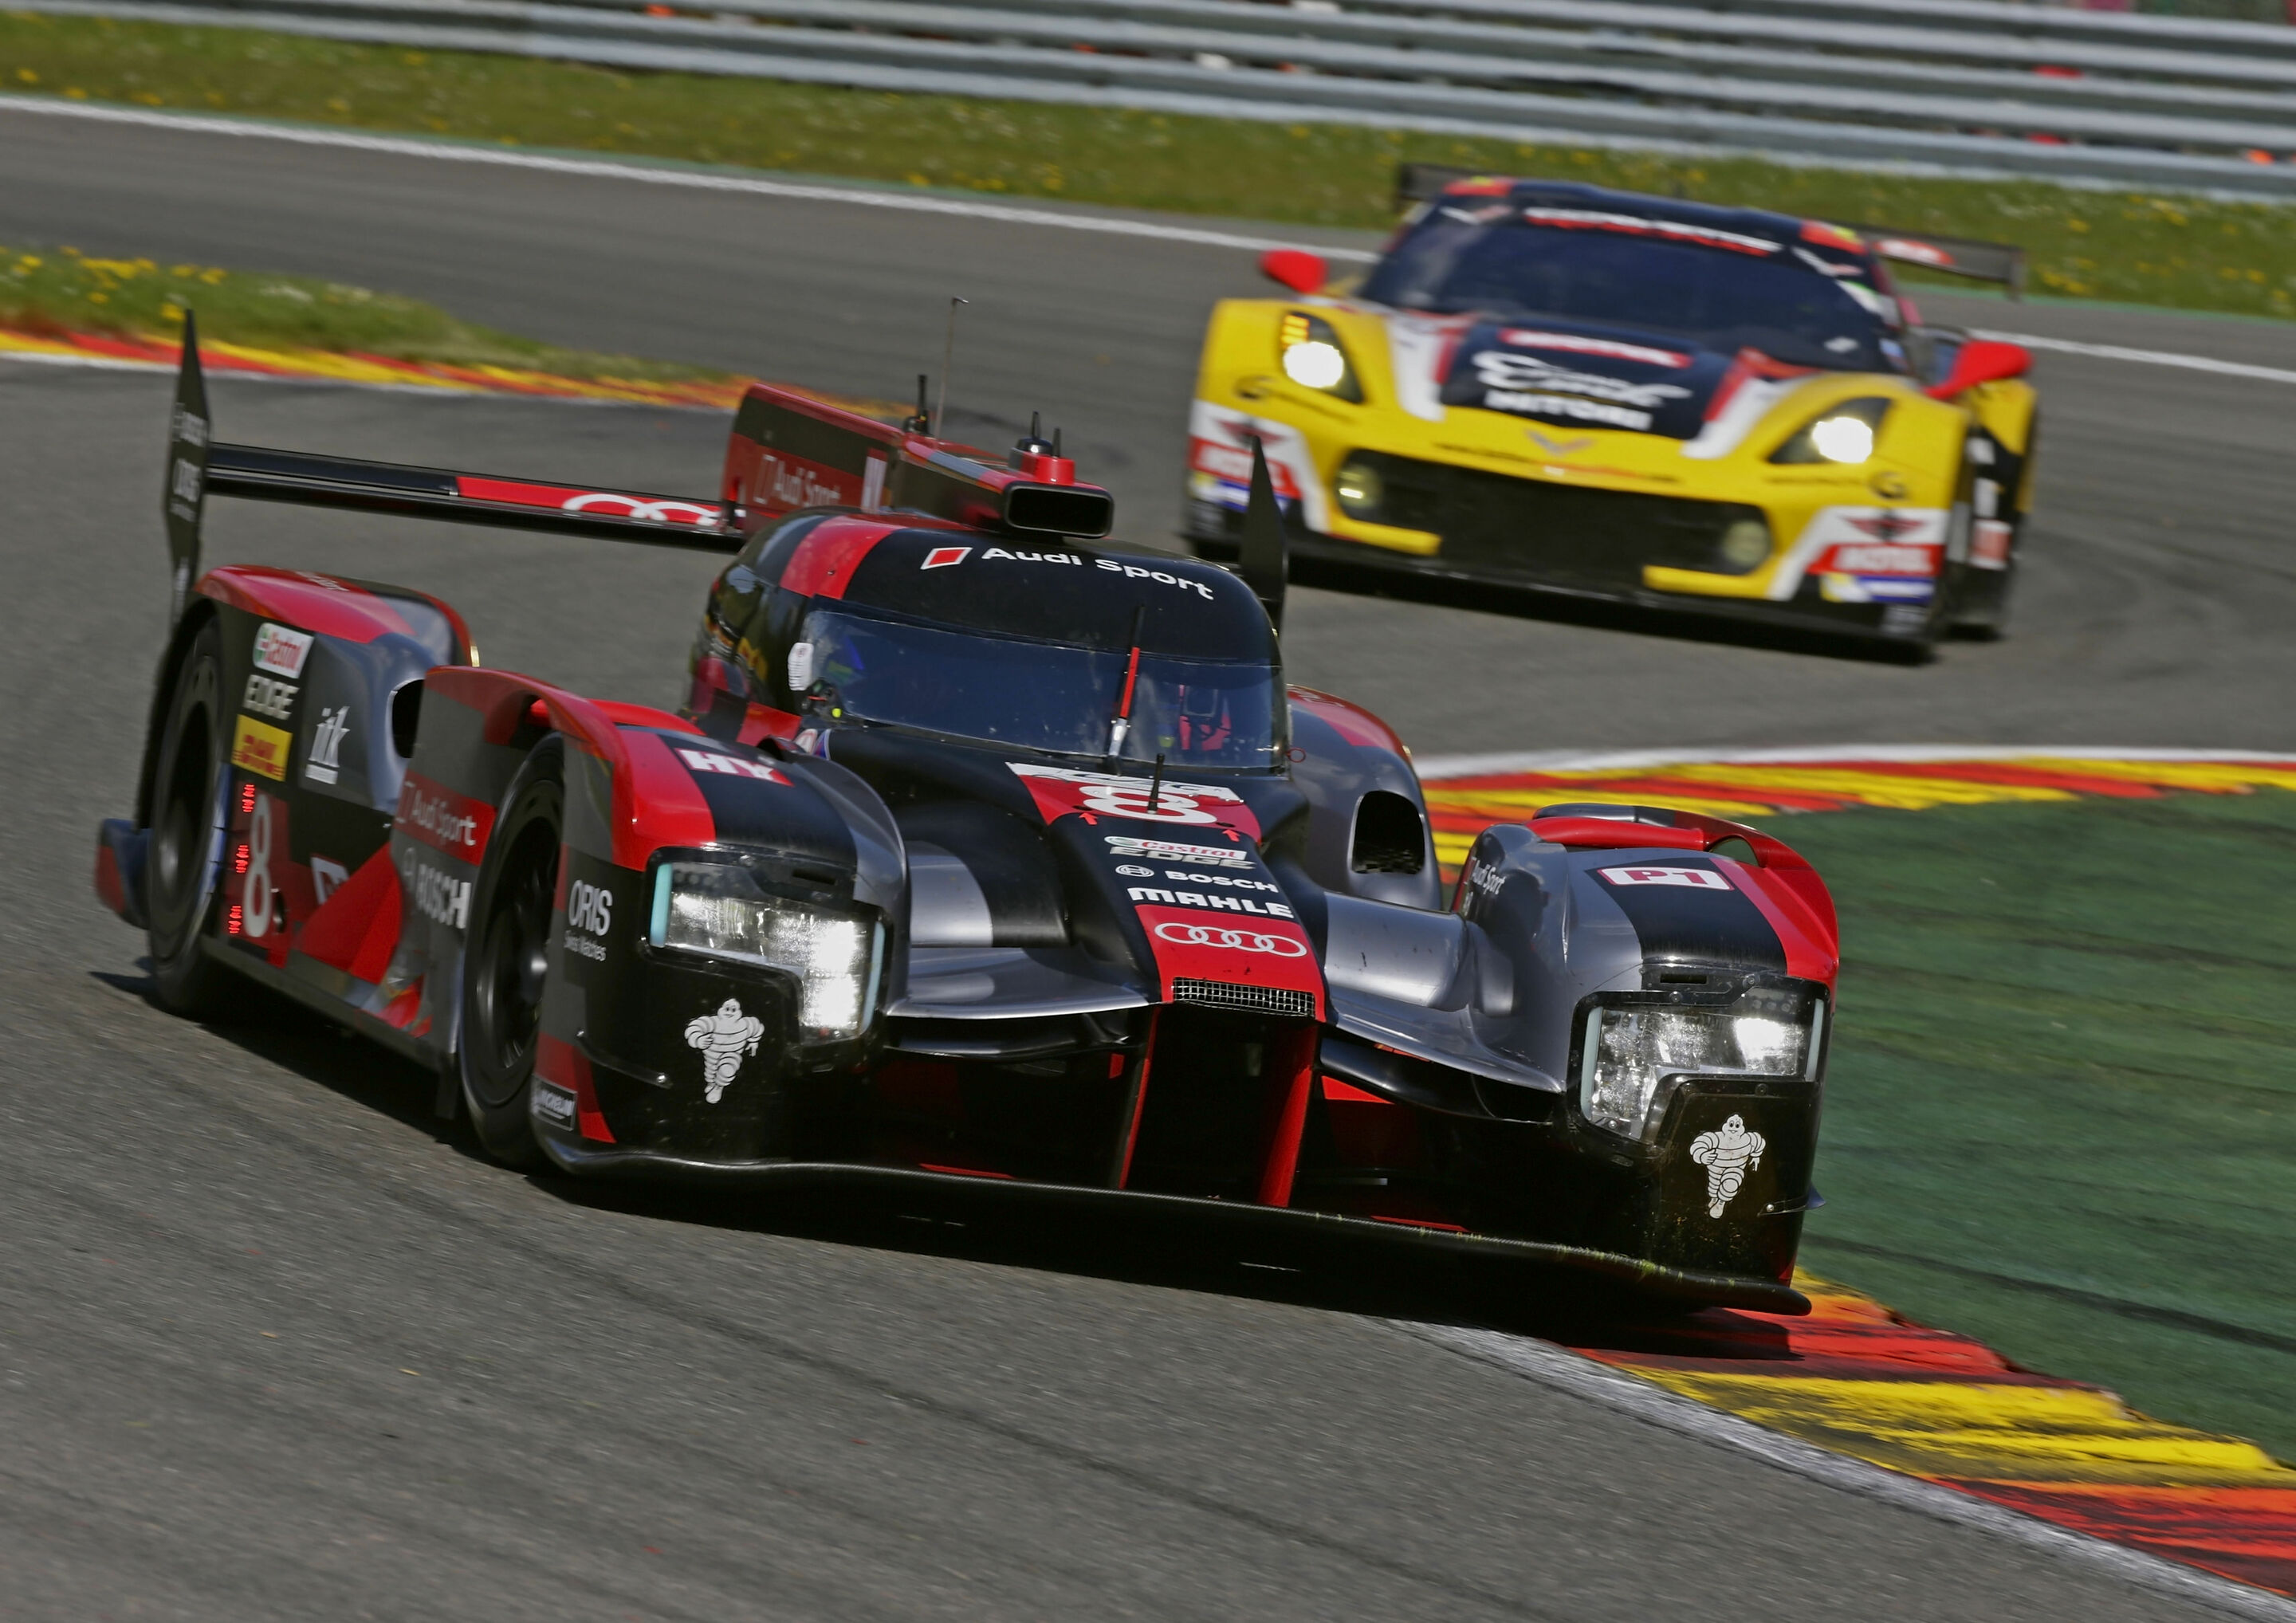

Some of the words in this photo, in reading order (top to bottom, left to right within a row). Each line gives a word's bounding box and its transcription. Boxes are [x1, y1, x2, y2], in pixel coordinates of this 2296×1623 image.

[981, 547, 1083, 566] Audi
[1095, 559, 1214, 600] Sport
[264, 632, 303, 670] Castrol
[242, 674, 300, 720] EDGE
[678, 748, 774, 781] HY
[412, 790, 444, 830] Audi
[437, 801, 477, 847] Sport
[1079, 785, 1217, 824] 8
[243, 794, 272, 937] 8
[1109, 846, 1257, 870] EDGE
[1142, 840, 1239, 859] Castrol
[416, 863, 471, 929] BOSCH
[1165, 870, 1279, 894] BOSCH
[1483, 867, 1506, 895] Sport
[1623, 870, 1709, 885] P1
[568, 879, 613, 937] ORIS
[1127, 887, 1294, 919] MAHLE
